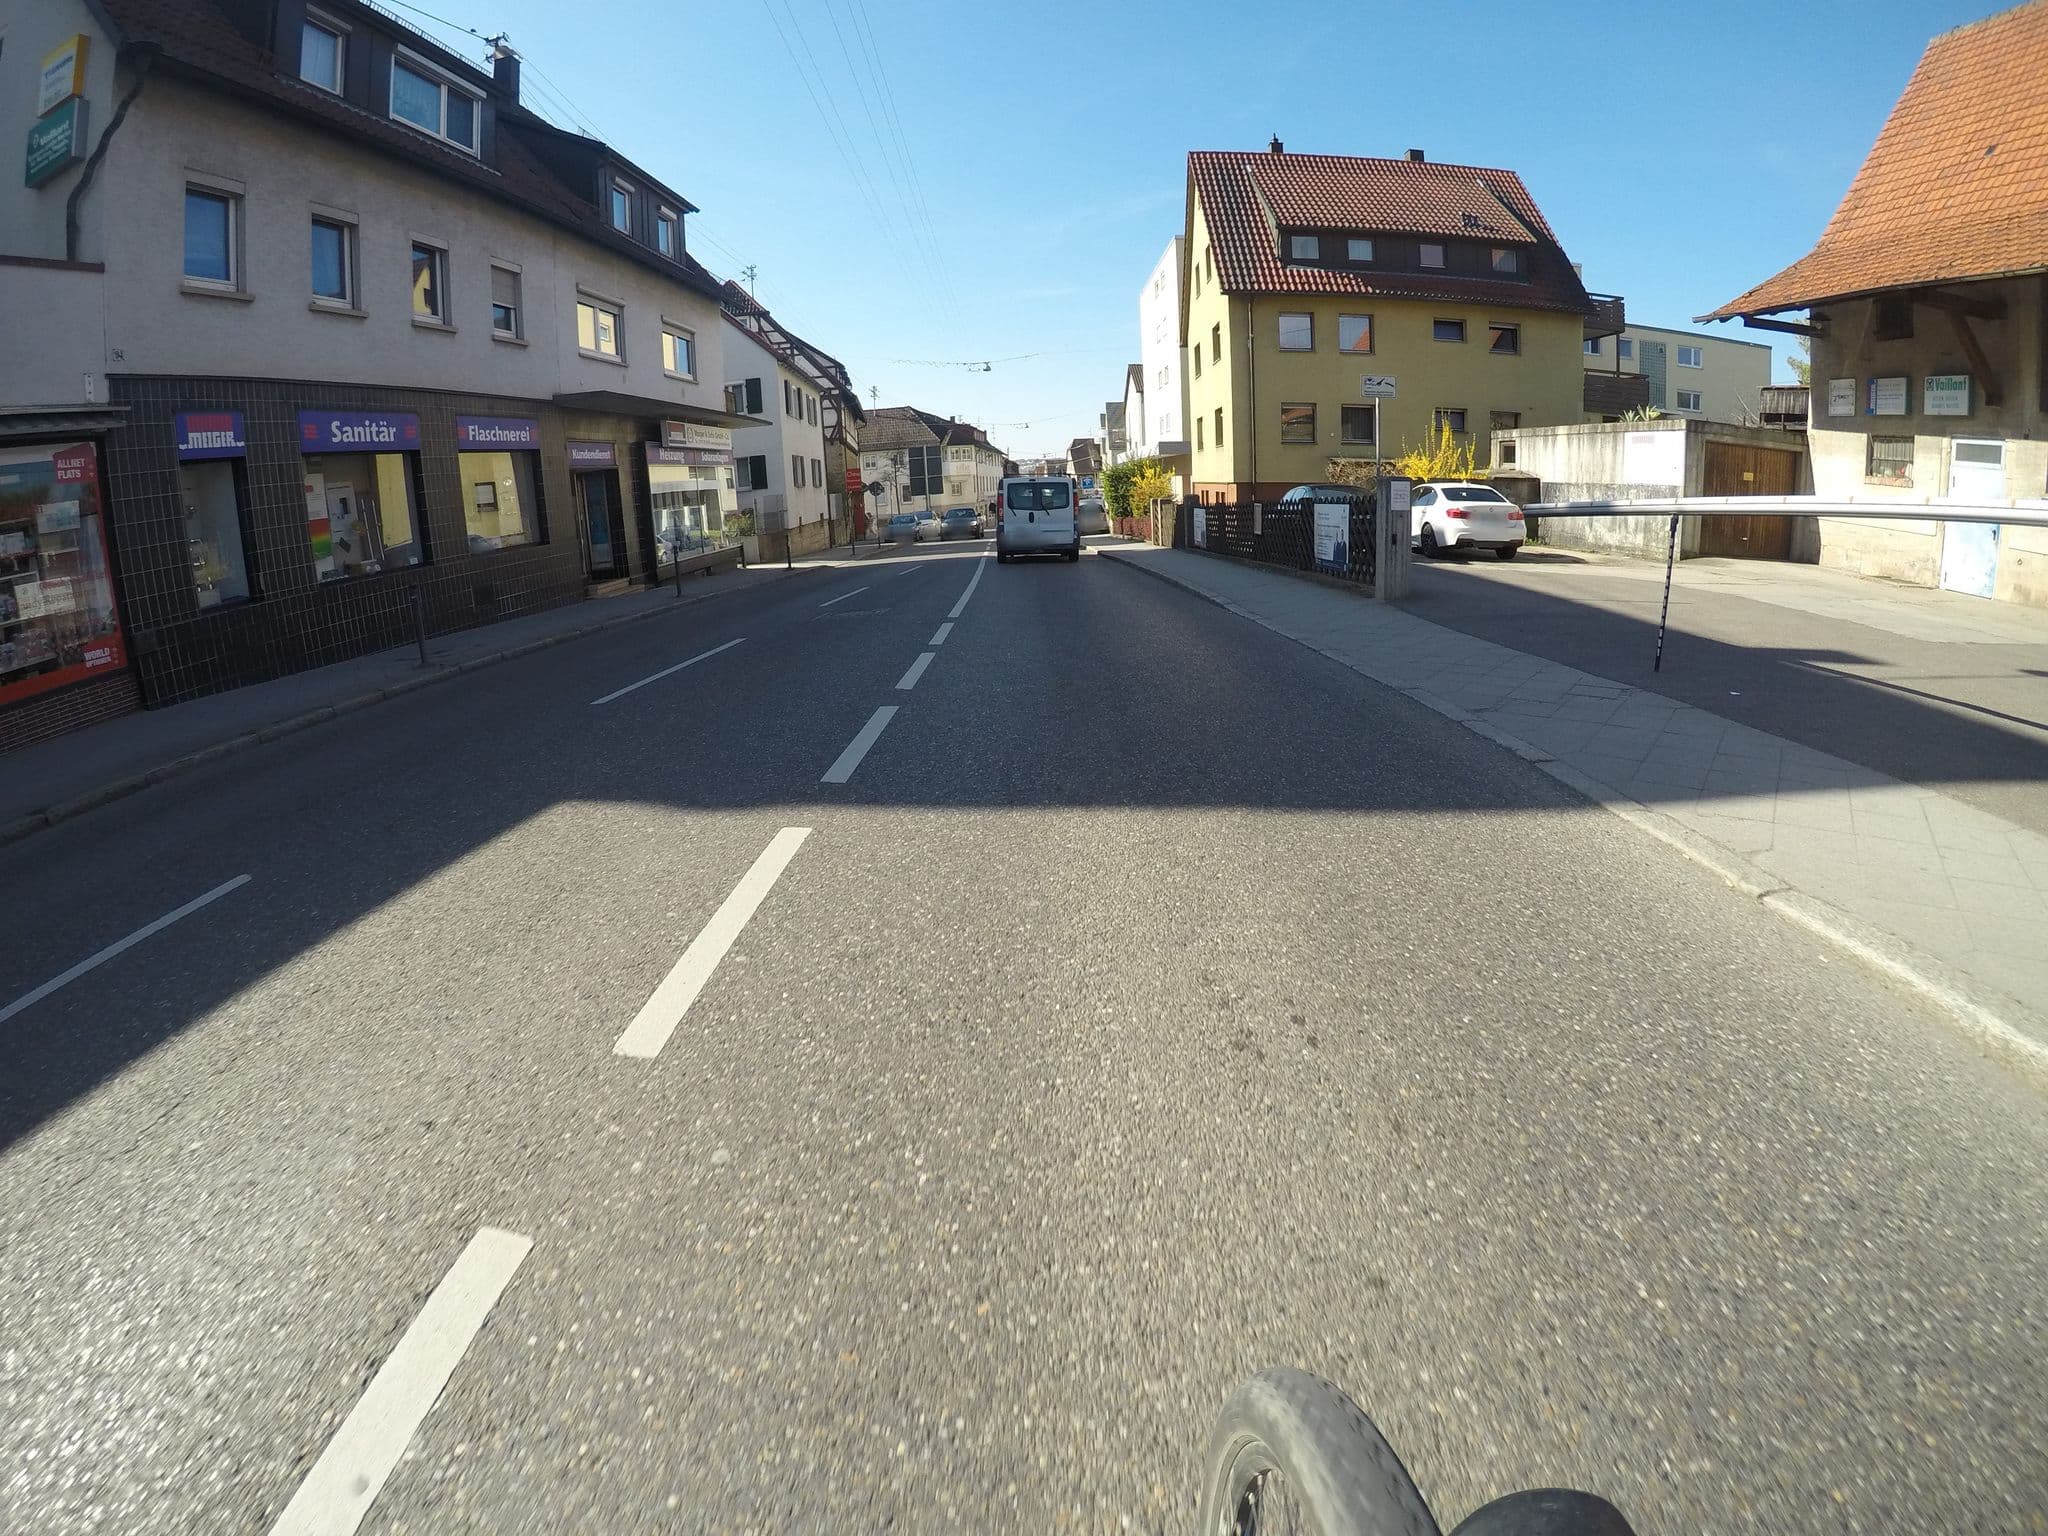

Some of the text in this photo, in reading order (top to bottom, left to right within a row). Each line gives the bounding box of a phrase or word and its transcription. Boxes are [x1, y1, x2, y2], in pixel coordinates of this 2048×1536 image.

[1935, 377, 1967, 391] Vaillant
[330, 420, 397, 443] Sanitär
[467, 424, 531, 442] Flaschnerei
[571, 448, 611, 460] Kundendienst
[658, 447, 685, 464] Heizung
[57, 457, 85, 468] ALLNET
[57, 469, 82, 480] FLATS
[84, 647, 110, 661] WORLD
